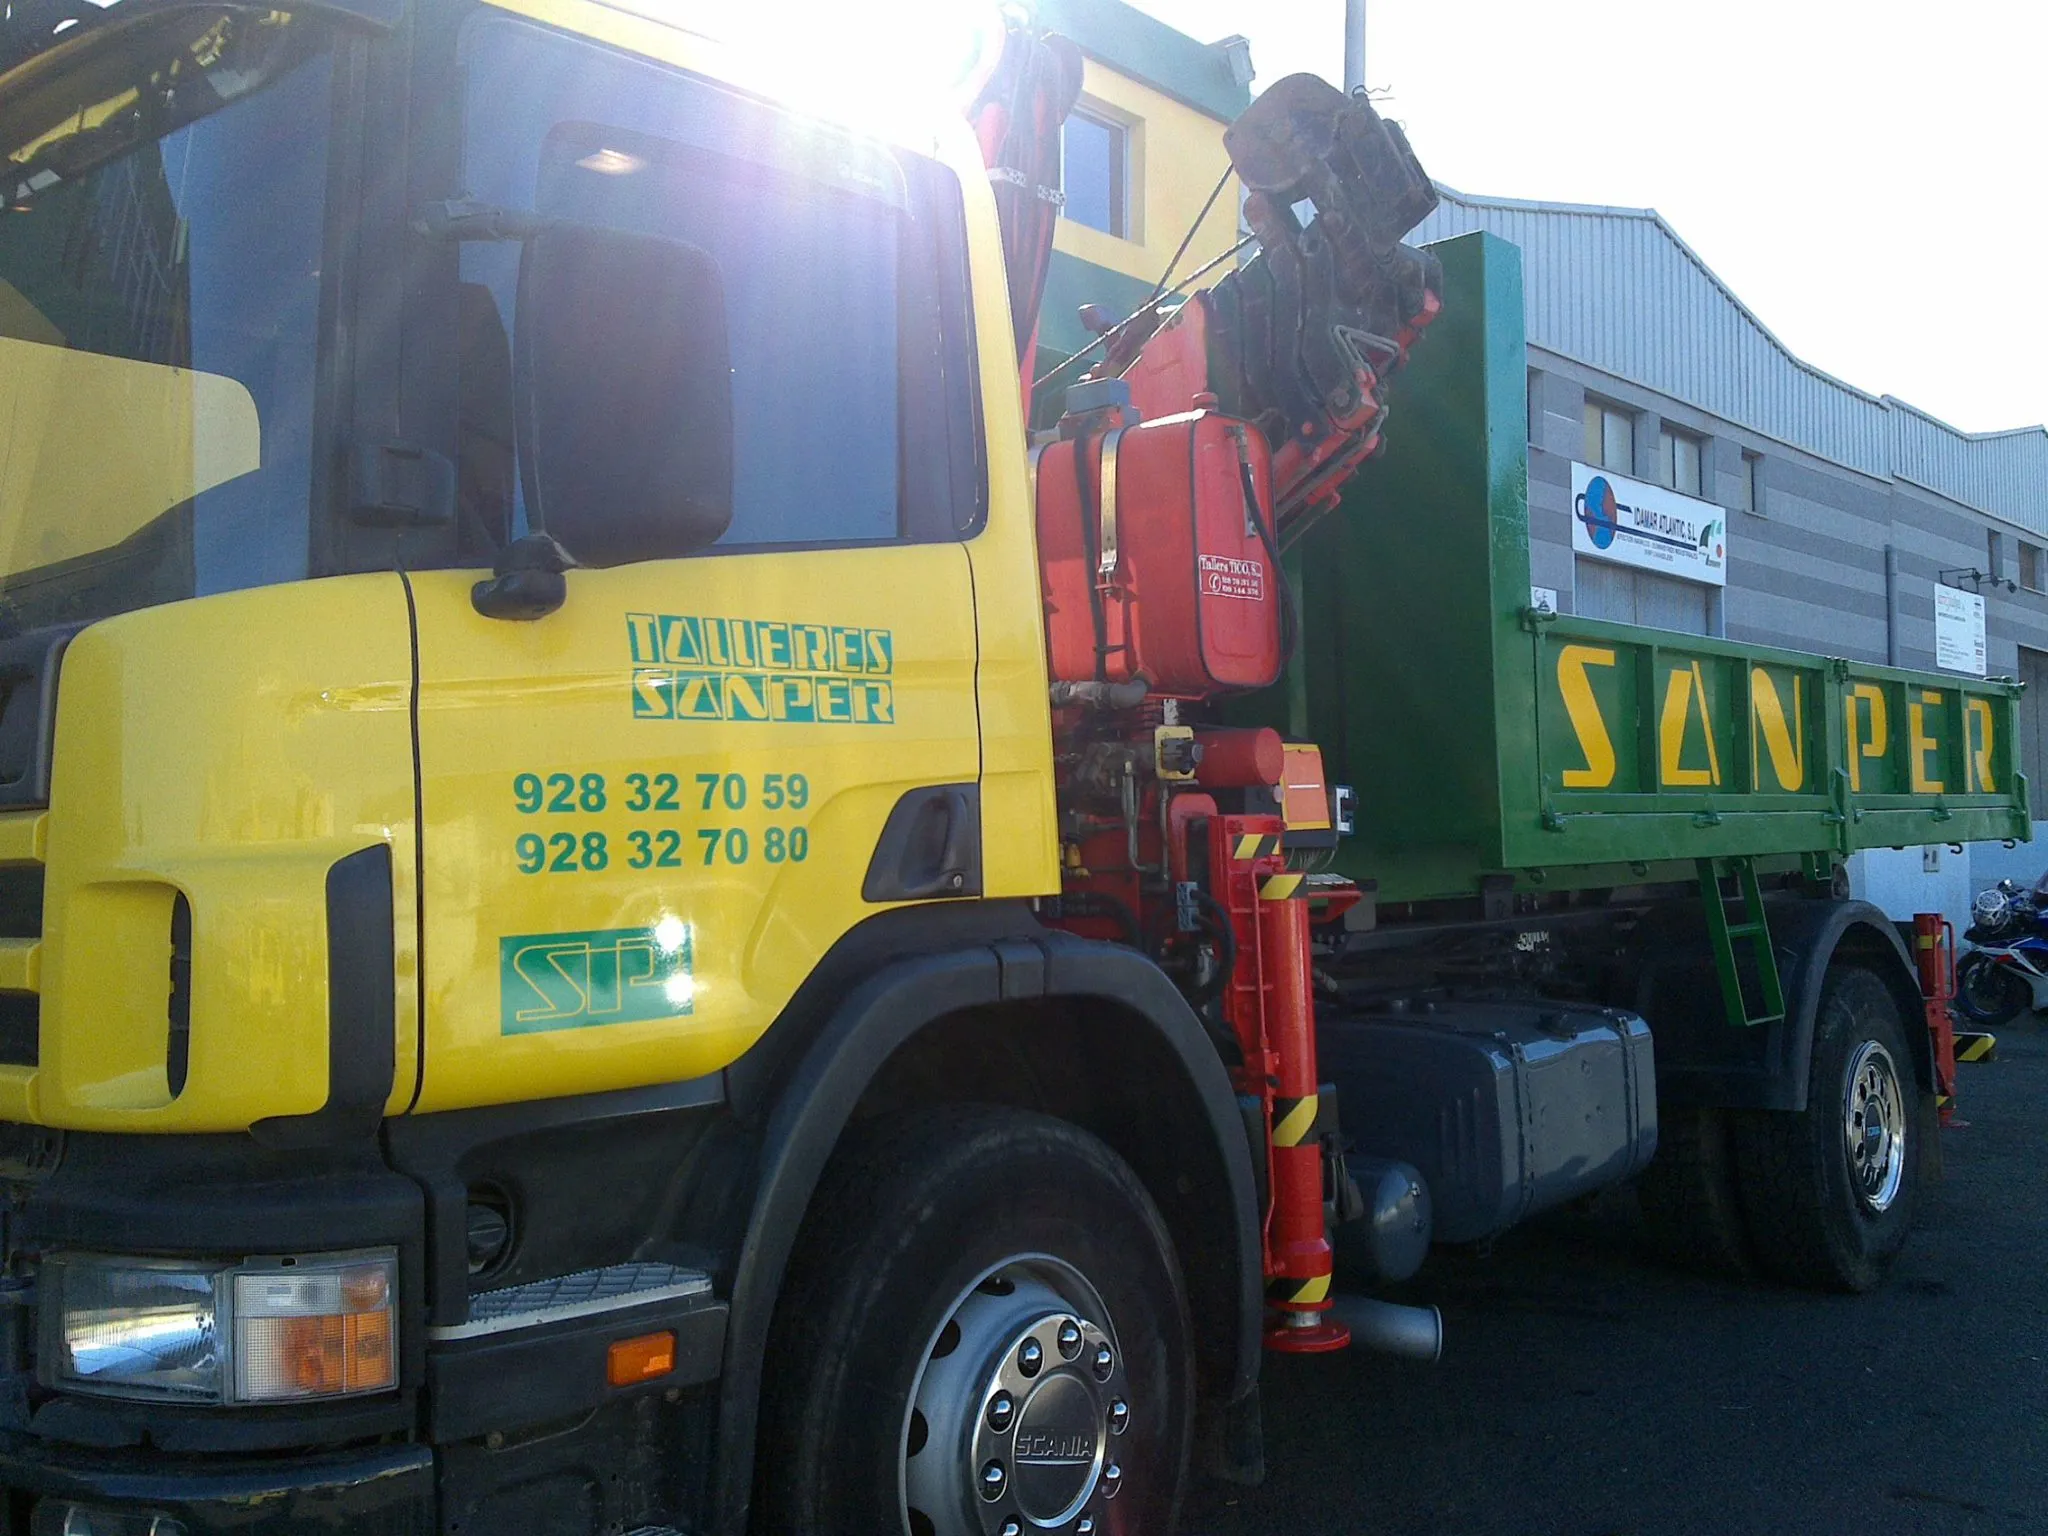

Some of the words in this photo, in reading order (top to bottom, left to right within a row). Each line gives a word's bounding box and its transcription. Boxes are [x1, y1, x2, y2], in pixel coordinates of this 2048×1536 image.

[626, 613, 892, 674] TALLERES
[632, 667, 895, 724] SANPER
[1557, 644, 1995, 793] SANPER
[513, 772, 607, 814] 928
[624, 773, 681, 812] 32
[695, 773, 747, 810] 70
[762, 773, 809, 810] 59
[515, 831, 609, 874] 928
[626, 829, 682, 868] 32
[697, 827, 749, 866] 70
[763, 825, 809, 864] 80
[1015, 1434, 1094, 1457] SCANIA
